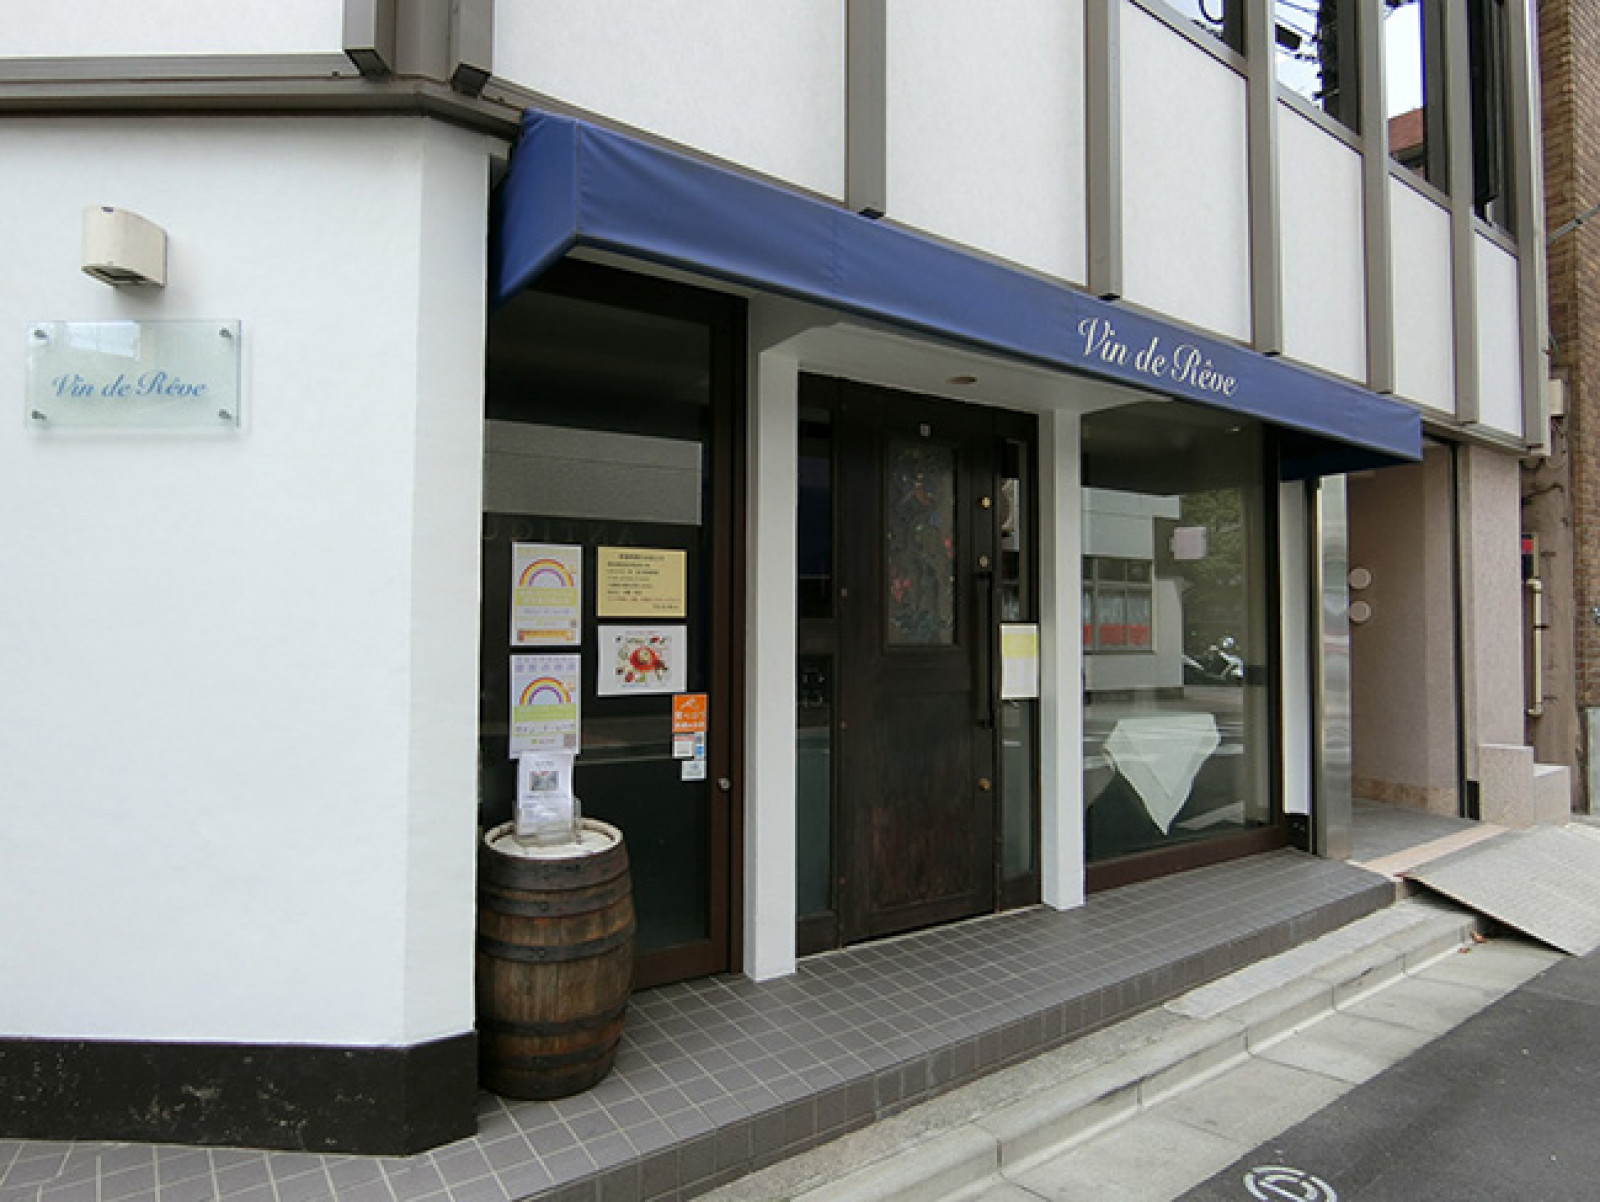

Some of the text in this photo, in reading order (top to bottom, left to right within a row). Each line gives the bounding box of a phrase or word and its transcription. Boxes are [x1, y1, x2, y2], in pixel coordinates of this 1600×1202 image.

[1077, 317, 1239, 397] Vin de Rêve
[52, 371, 207, 397] Vin de Rêve
